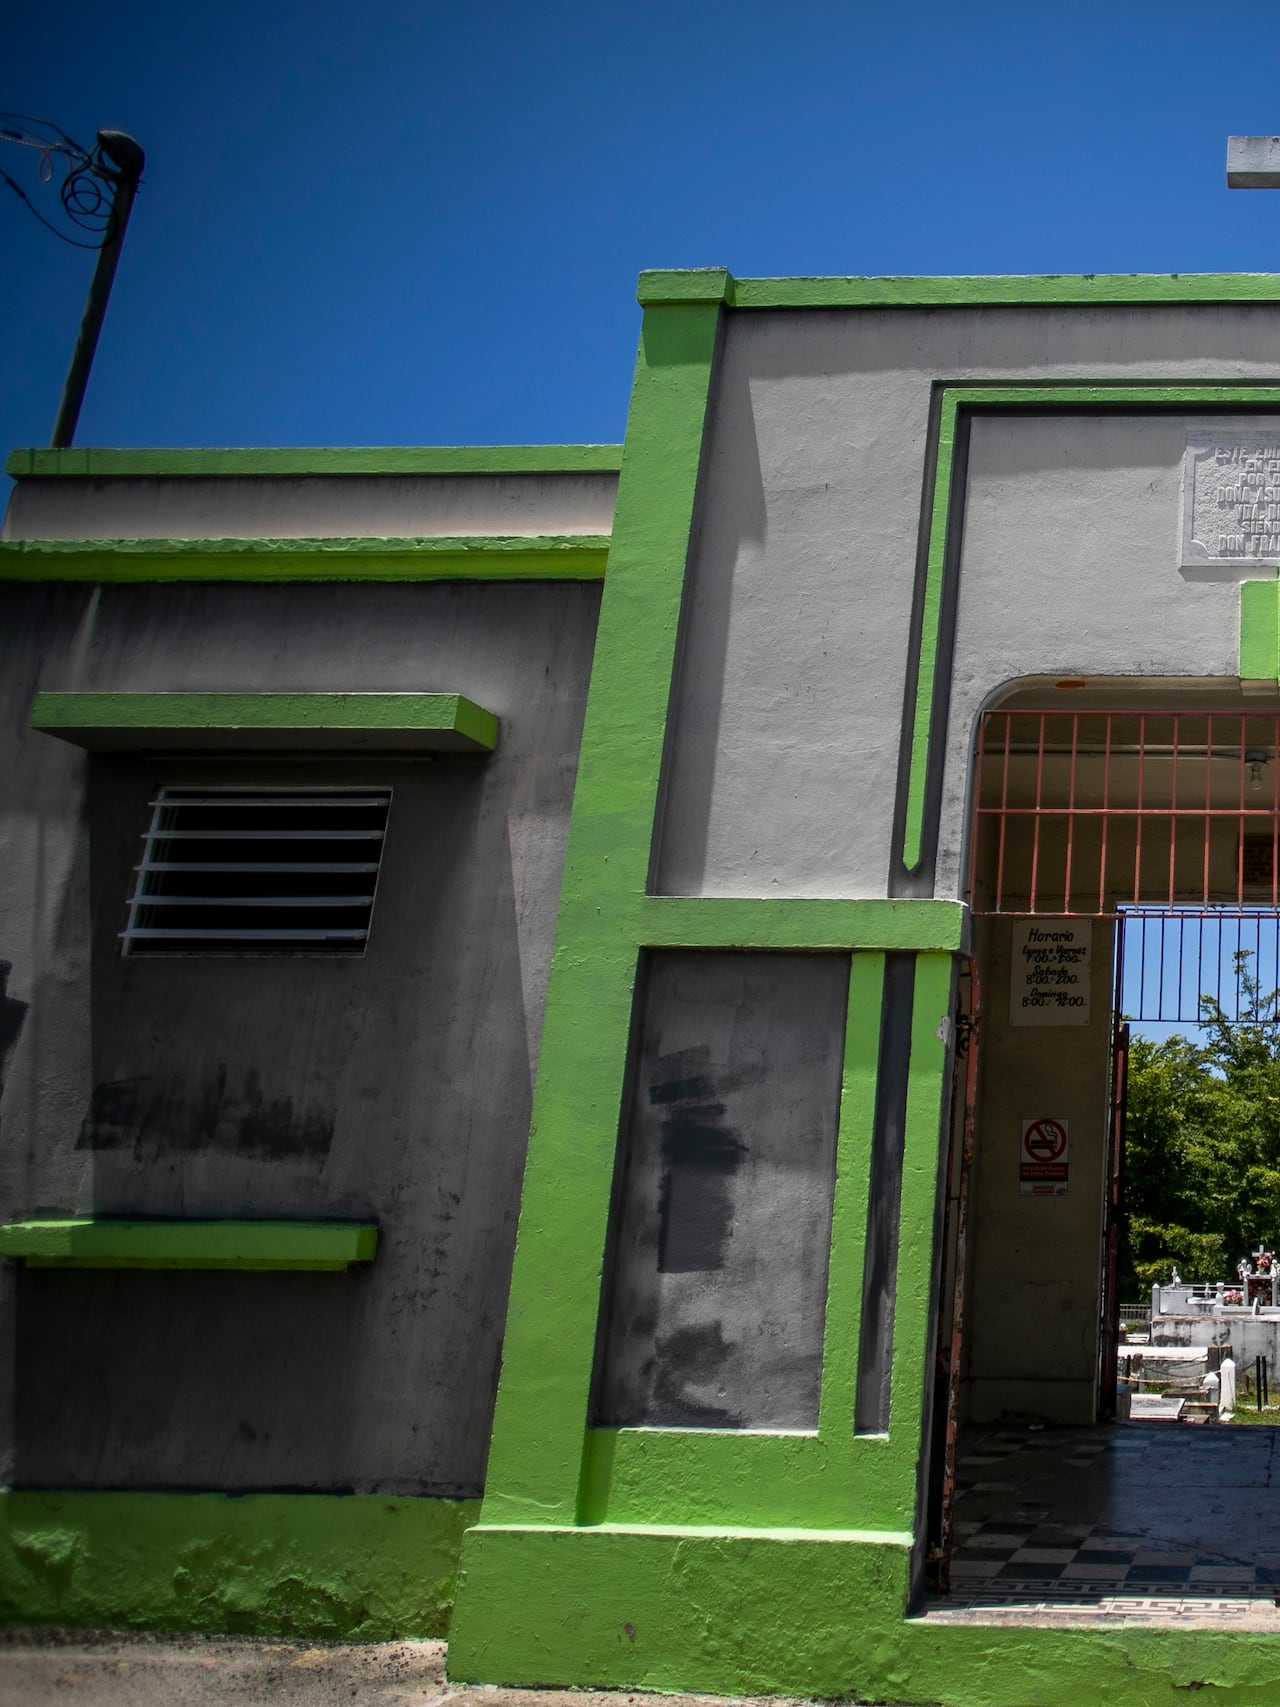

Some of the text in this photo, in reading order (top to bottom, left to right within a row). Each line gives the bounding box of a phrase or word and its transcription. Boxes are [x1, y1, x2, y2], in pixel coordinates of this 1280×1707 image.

[1215, 448, 1248, 458] ESTE
[1246, 460, 1263, 472] EN
[1239, 473, 1264, 485] POR
[1217, 485, 1253, 503] DOÑA
[1219, 536, 1245, 551] DON
[1028, 928, 1074, 942] Horario
